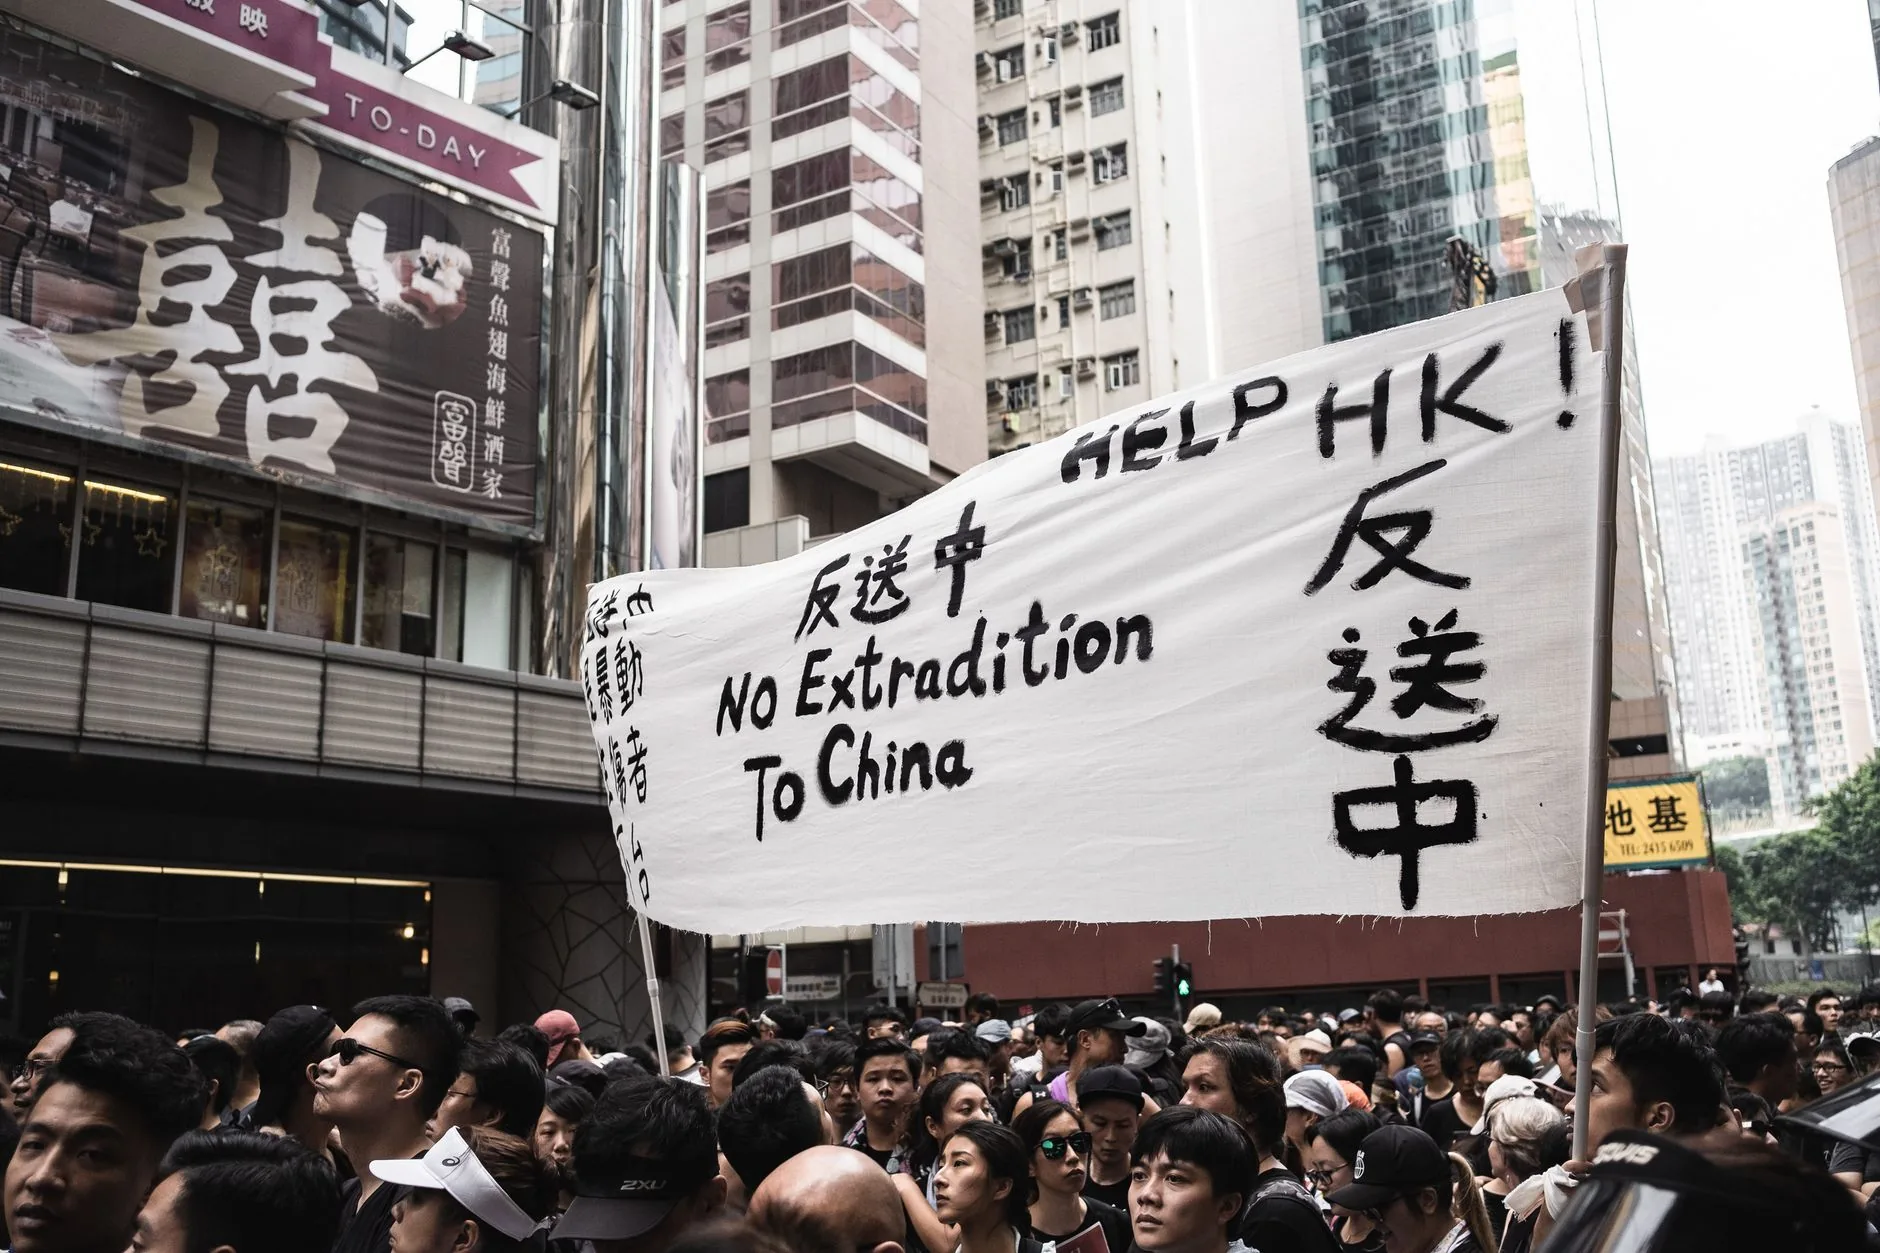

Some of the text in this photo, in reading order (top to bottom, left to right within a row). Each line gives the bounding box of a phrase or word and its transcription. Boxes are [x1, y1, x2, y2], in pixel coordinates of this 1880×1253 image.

[345, 92, 488, 169] TO-DAY
[480, 227, 511, 499] 富聲魚翅海鮮酒家
[1060, 375, 1289, 484] HELP
[793, 499, 986, 644] 反送中
[795, 597, 1155, 719] Extradition
[1303, 458, 1498, 911] 反送中
[743, 722, 975, 843] To China
[620, 1179, 668, 1191] 2XU
